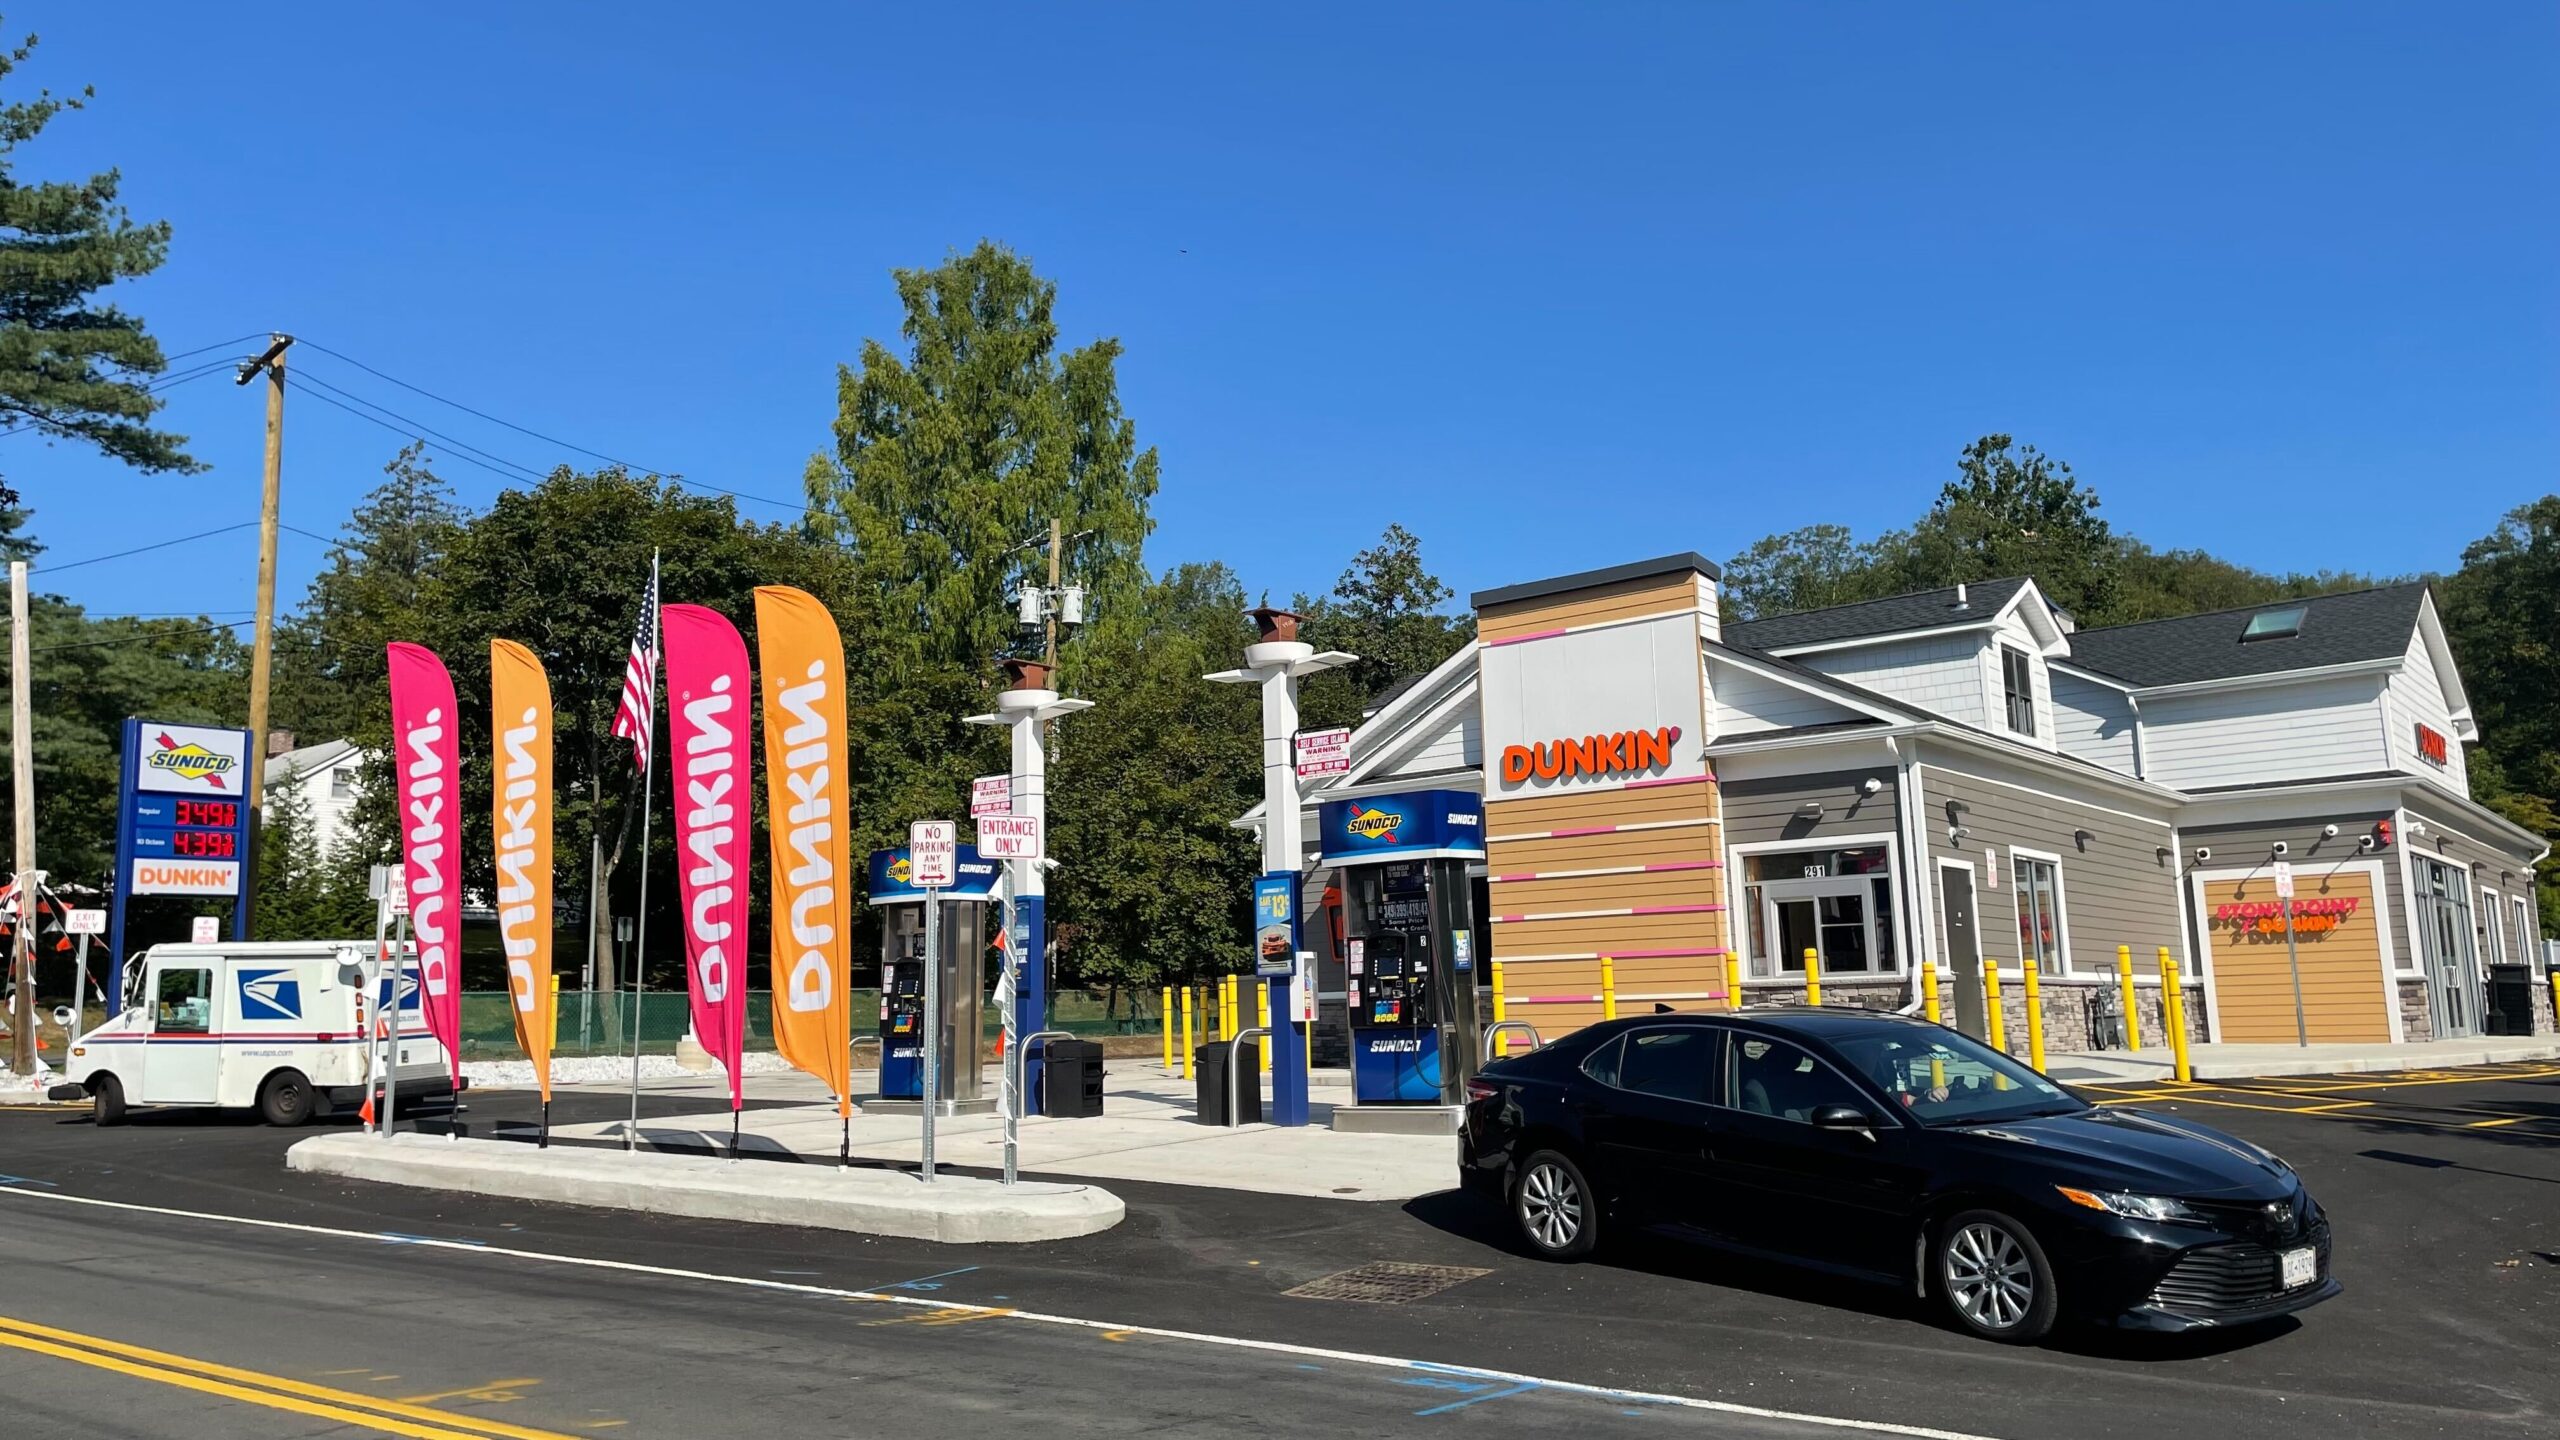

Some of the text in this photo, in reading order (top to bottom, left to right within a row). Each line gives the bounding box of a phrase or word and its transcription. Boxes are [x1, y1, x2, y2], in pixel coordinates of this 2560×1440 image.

[1305, 745, 1341, 755] WARNING
[1504, 726, 1681, 782] DUNKIN'
[154, 753, 230, 770] SUNOCO
[1350, 815, 1399, 832] SUNOCO
[1447, 813, 1478, 826] SUNOCO
[925, 828, 941, 838] NO
[982, 820, 1035, 836] ENTRANCE
[914, 841, 951, 854] PARKING
[995, 837, 1022, 853] ONLY
[924, 854, 941, 863] ANY
[887, 866, 911, 877] SUNO
[923, 864, 942, 873] TIME
[958, 863, 993, 874] SUNOCO
[1805, 866, 1825, 878] 291
[140, 867, 232, 887] DUNKIN'
[2217, 897, 2359, 918] STONY POINT
[76, 913, 96, 921] EXIT
[72, 921, 98, 930] ONLY
[241, 1049, 294, 1059] www.usps.com
